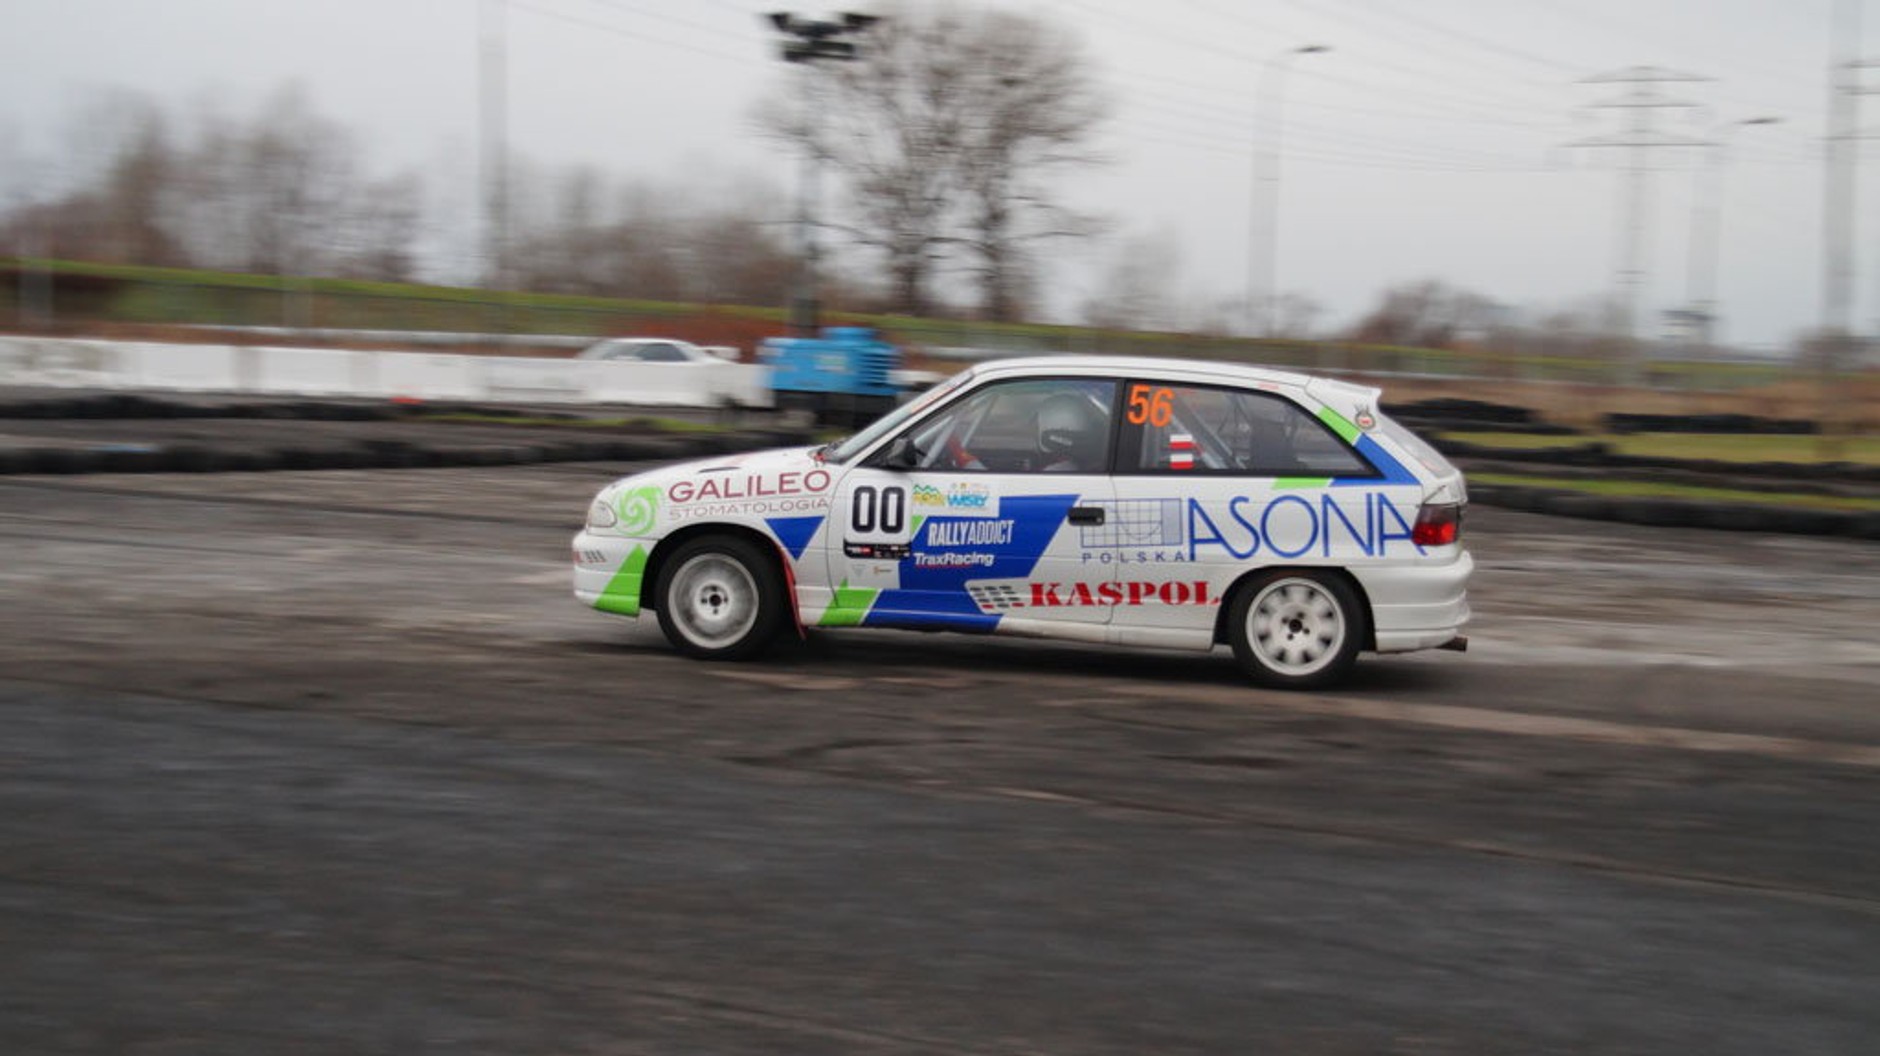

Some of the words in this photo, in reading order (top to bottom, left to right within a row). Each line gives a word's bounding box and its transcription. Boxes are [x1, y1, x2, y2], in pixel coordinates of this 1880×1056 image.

[1128, 384, 1174, 427] 56
[668, 470, 831, 502] GALILEO
[669, 498, 829, 520] STOMATOLOGIA
[852, 486, 905, 533] 00
[1188, 493, 1427, 561] ASONA
[913, 552, 994, 566] TraxRacing
[1082, 551, 1186, 563] POLSKA
[1030, 581, 1222, 607] KASPOL
